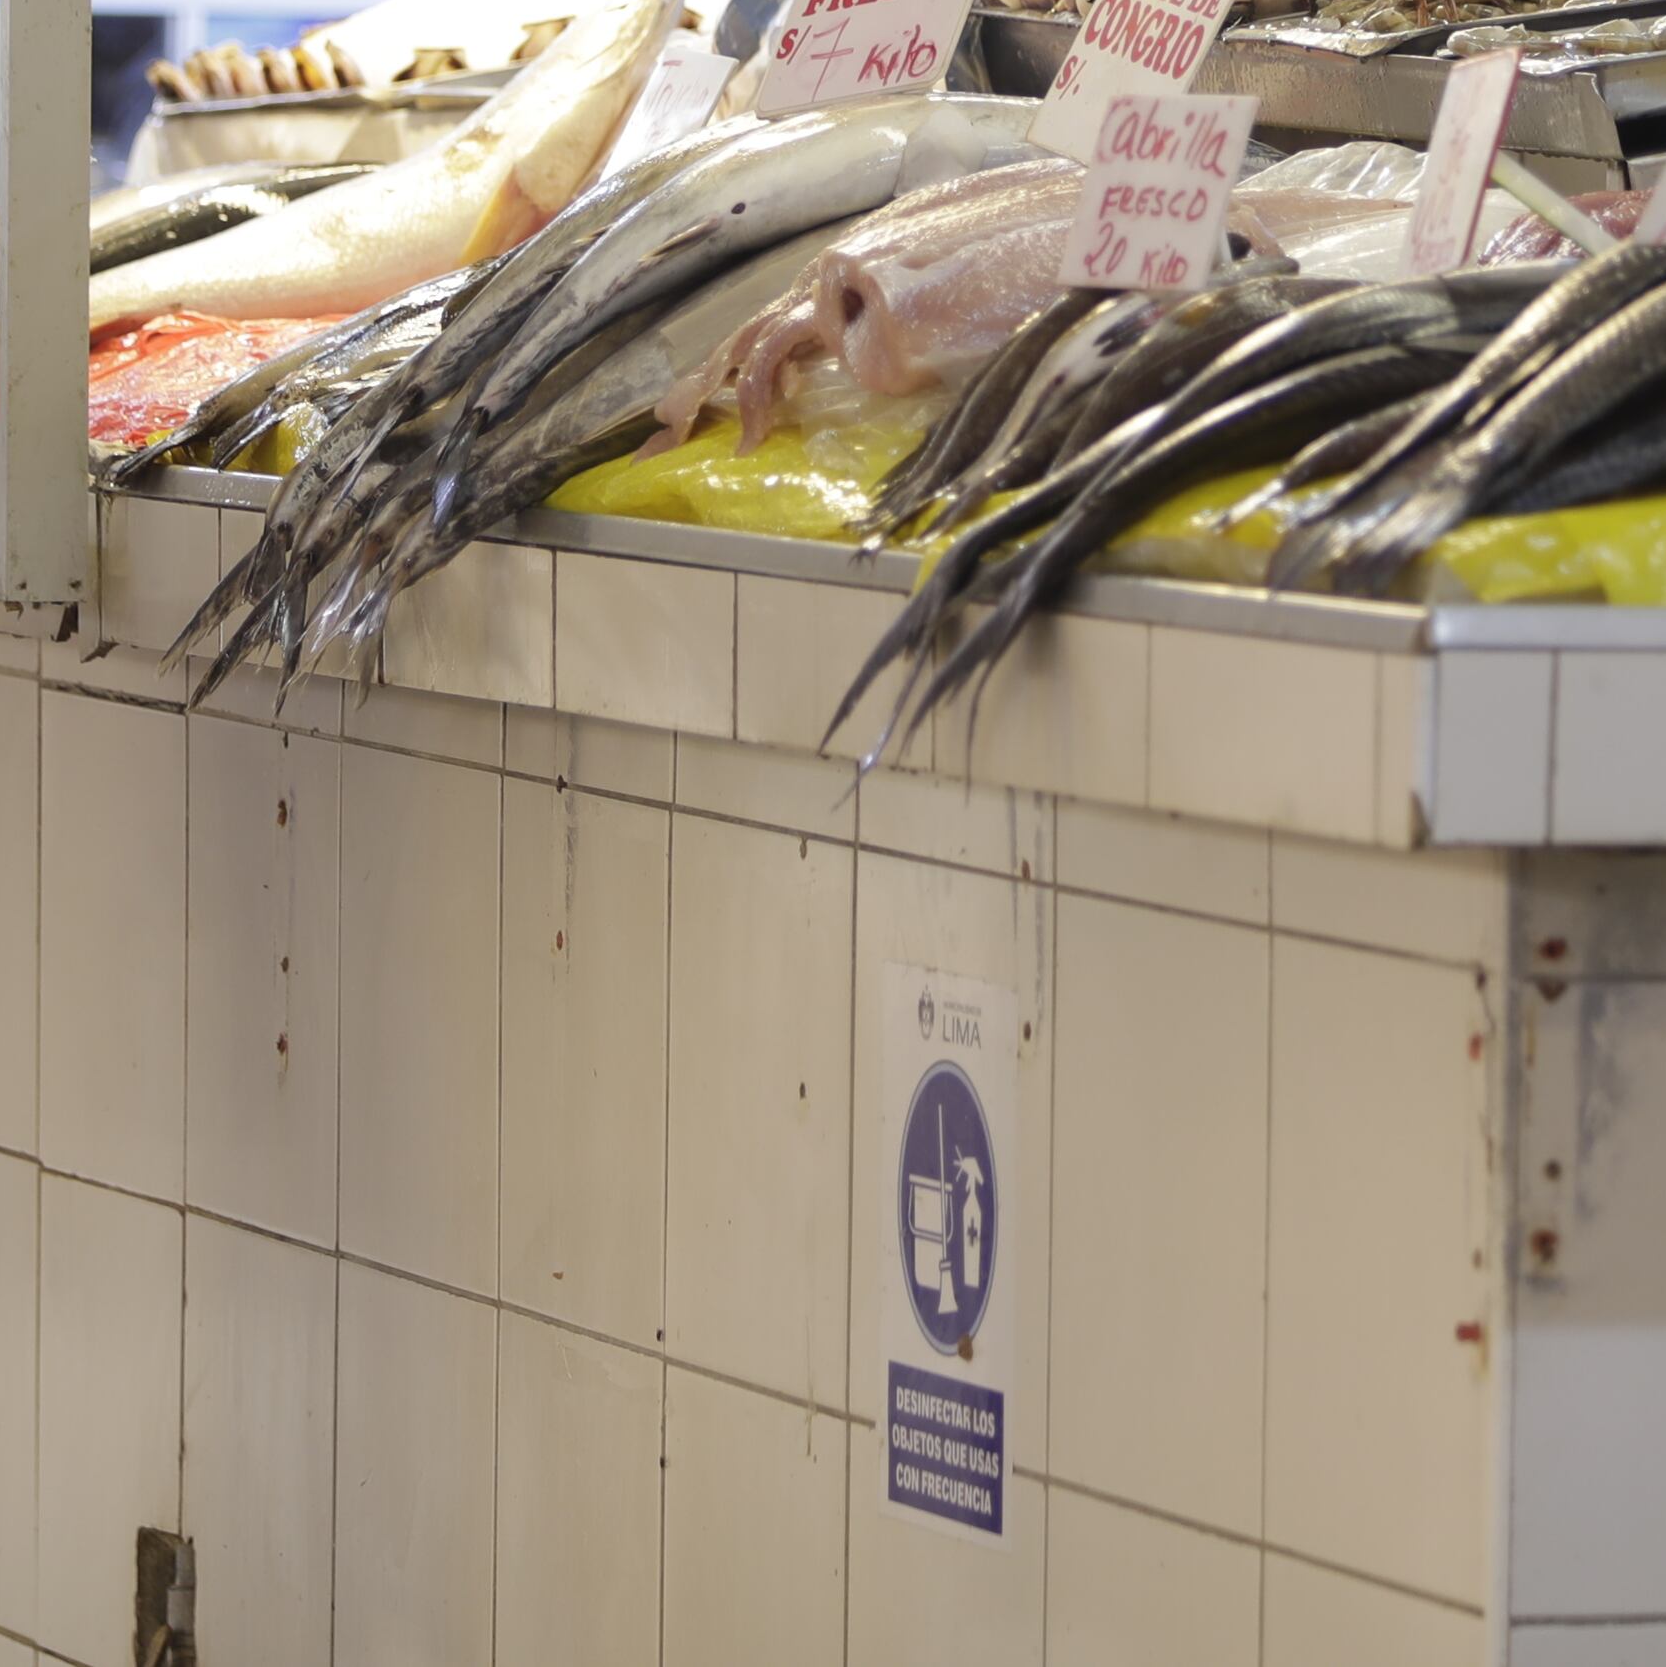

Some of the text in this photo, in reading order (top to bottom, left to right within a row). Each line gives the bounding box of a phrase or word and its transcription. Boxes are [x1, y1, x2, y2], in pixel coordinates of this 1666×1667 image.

[810, 16, 855, 103] 7
[1055, 54, 1087, 101] S/.
[1098, 186, 1208, 223] FRESCO
[1083, 222, 1128, 278] 20
[942, 1014, 982, 1050] LIMA
[895, 1386, 995, 1438] DESINFECTAR LOS
[892, 1423, 999, 1479] OBJETOS QUE USAS
[895, 1462, 992, 1516] CON FRECUENCIA
